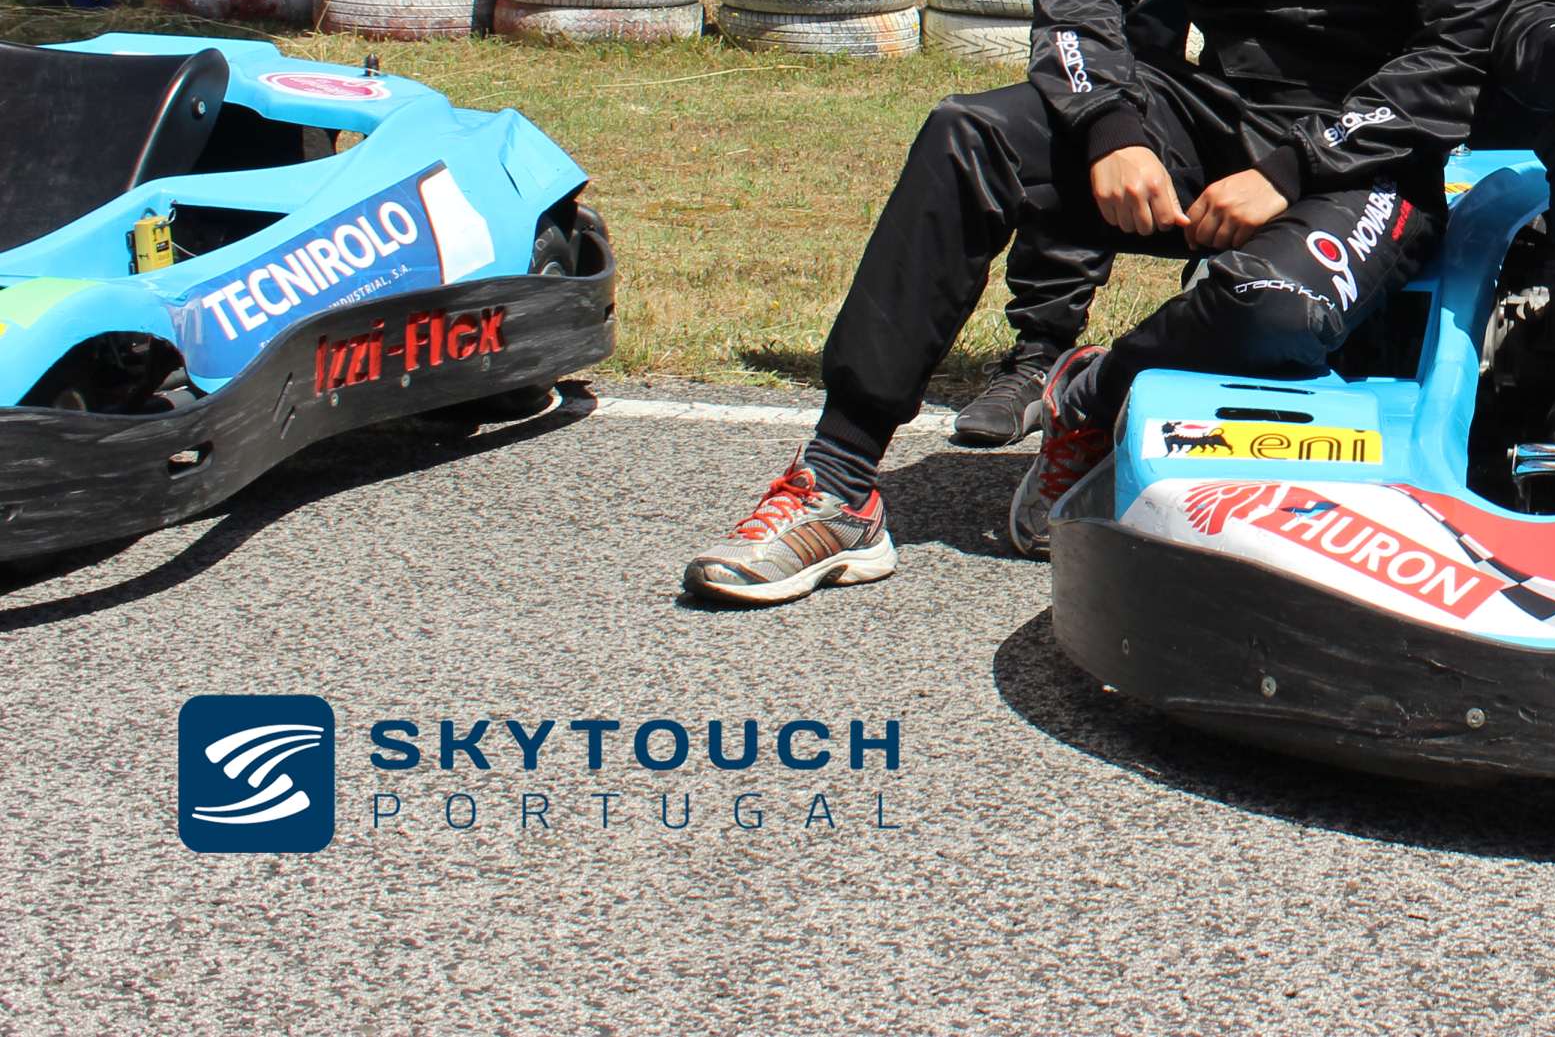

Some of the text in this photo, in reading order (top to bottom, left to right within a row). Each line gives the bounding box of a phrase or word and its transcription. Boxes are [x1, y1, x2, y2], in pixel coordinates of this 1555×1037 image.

[1323, 106, 1396, 148] sparco
[200, 200, 419, 342] TECNIROLO
[1250, 429, 1367, 461] eni
[1280, 499, 1482, 609] HURON
